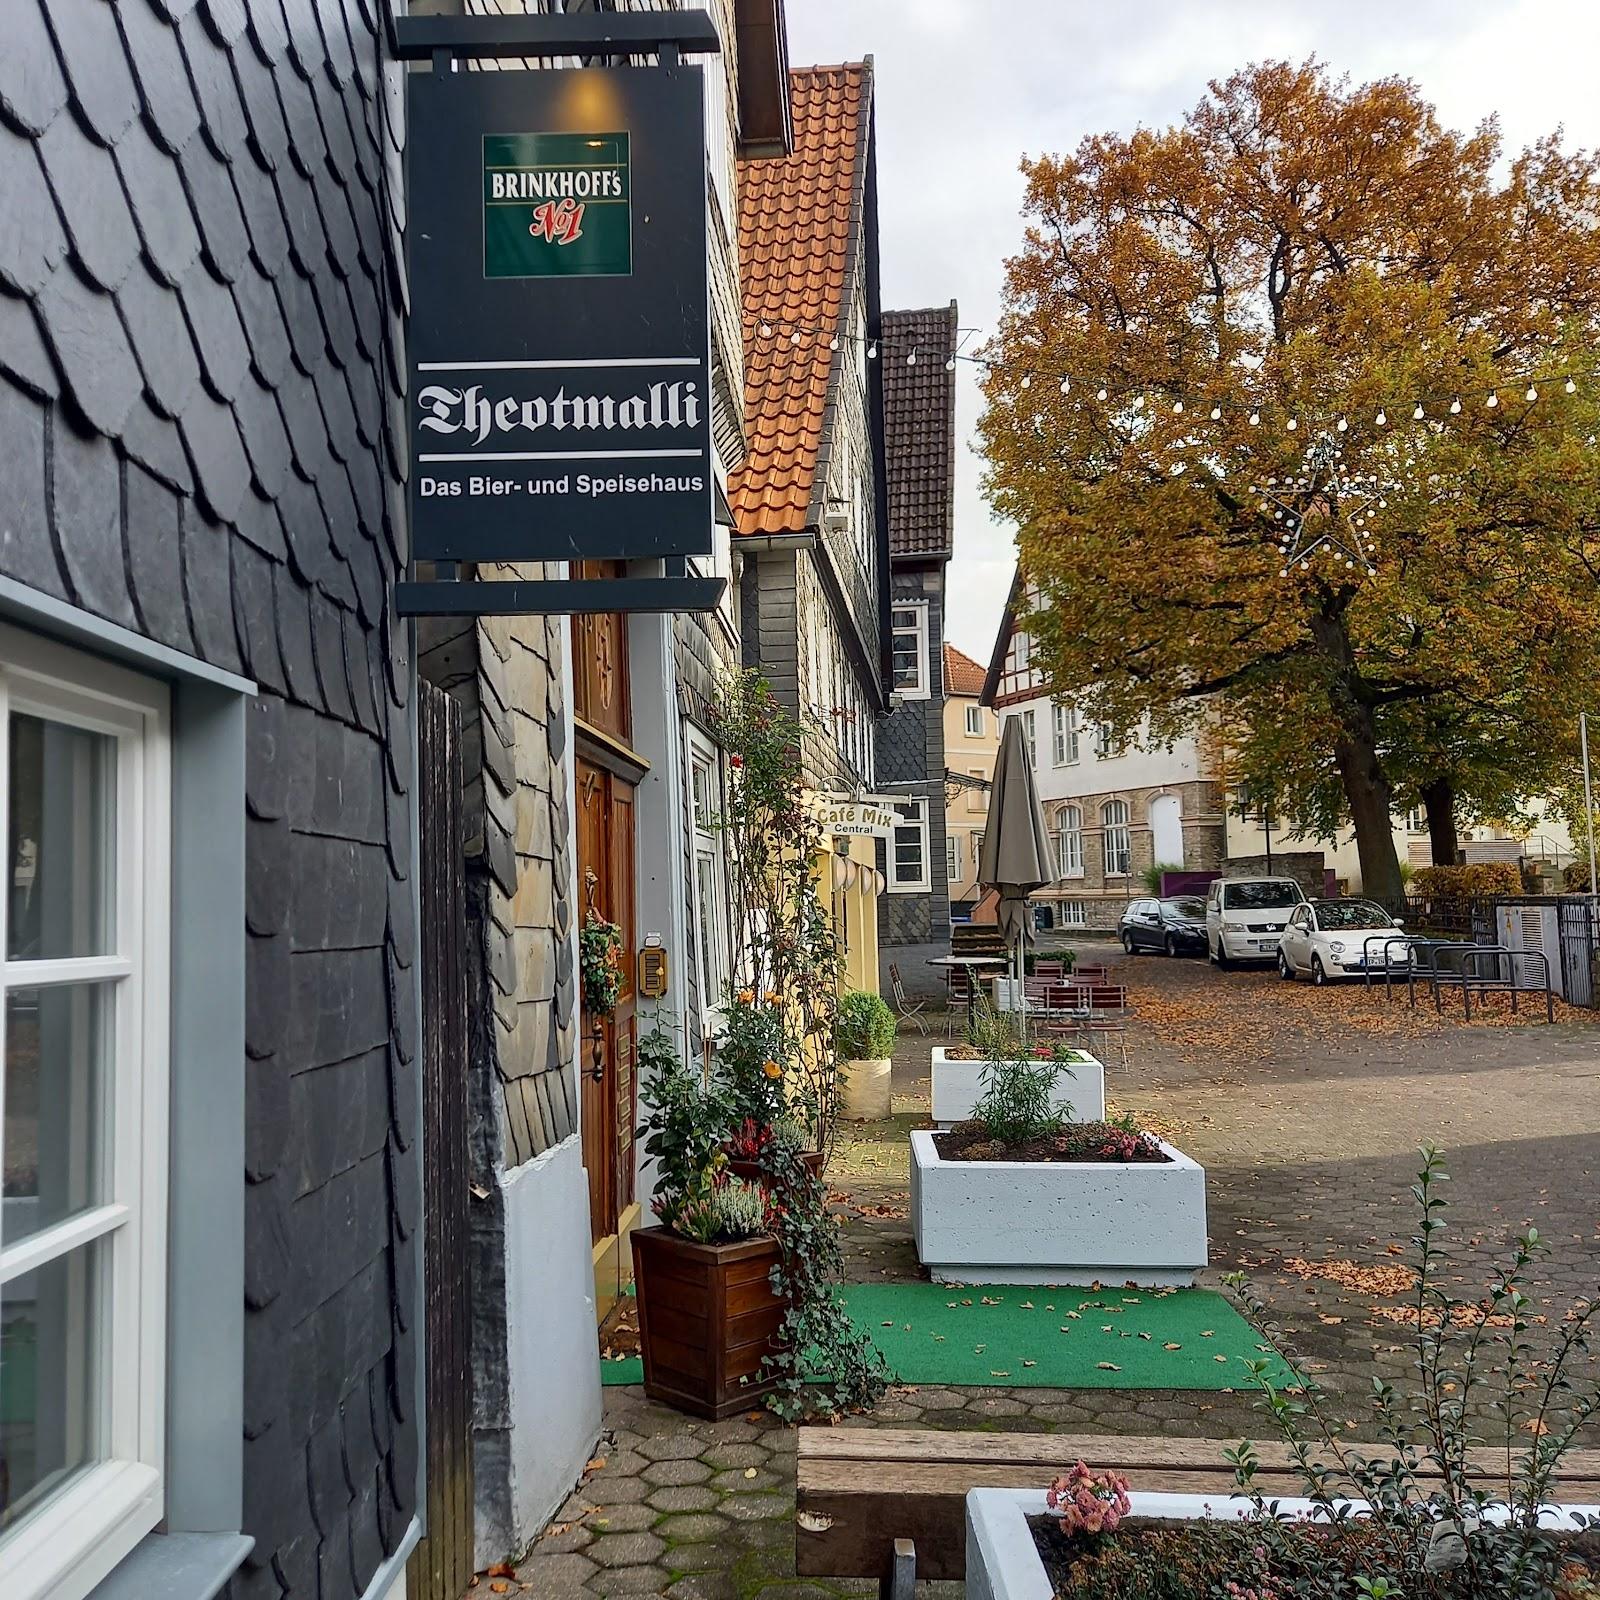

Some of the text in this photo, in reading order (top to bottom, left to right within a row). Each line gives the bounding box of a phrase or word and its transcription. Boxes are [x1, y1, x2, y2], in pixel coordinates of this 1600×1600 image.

[417, 381, 702, 446] Theotmalli
[420, 474, 704, 498] Das Bier- und Speisehaus
[817, 807, 891, 827] Café Mix
[834, 824, 873, 834] Central
